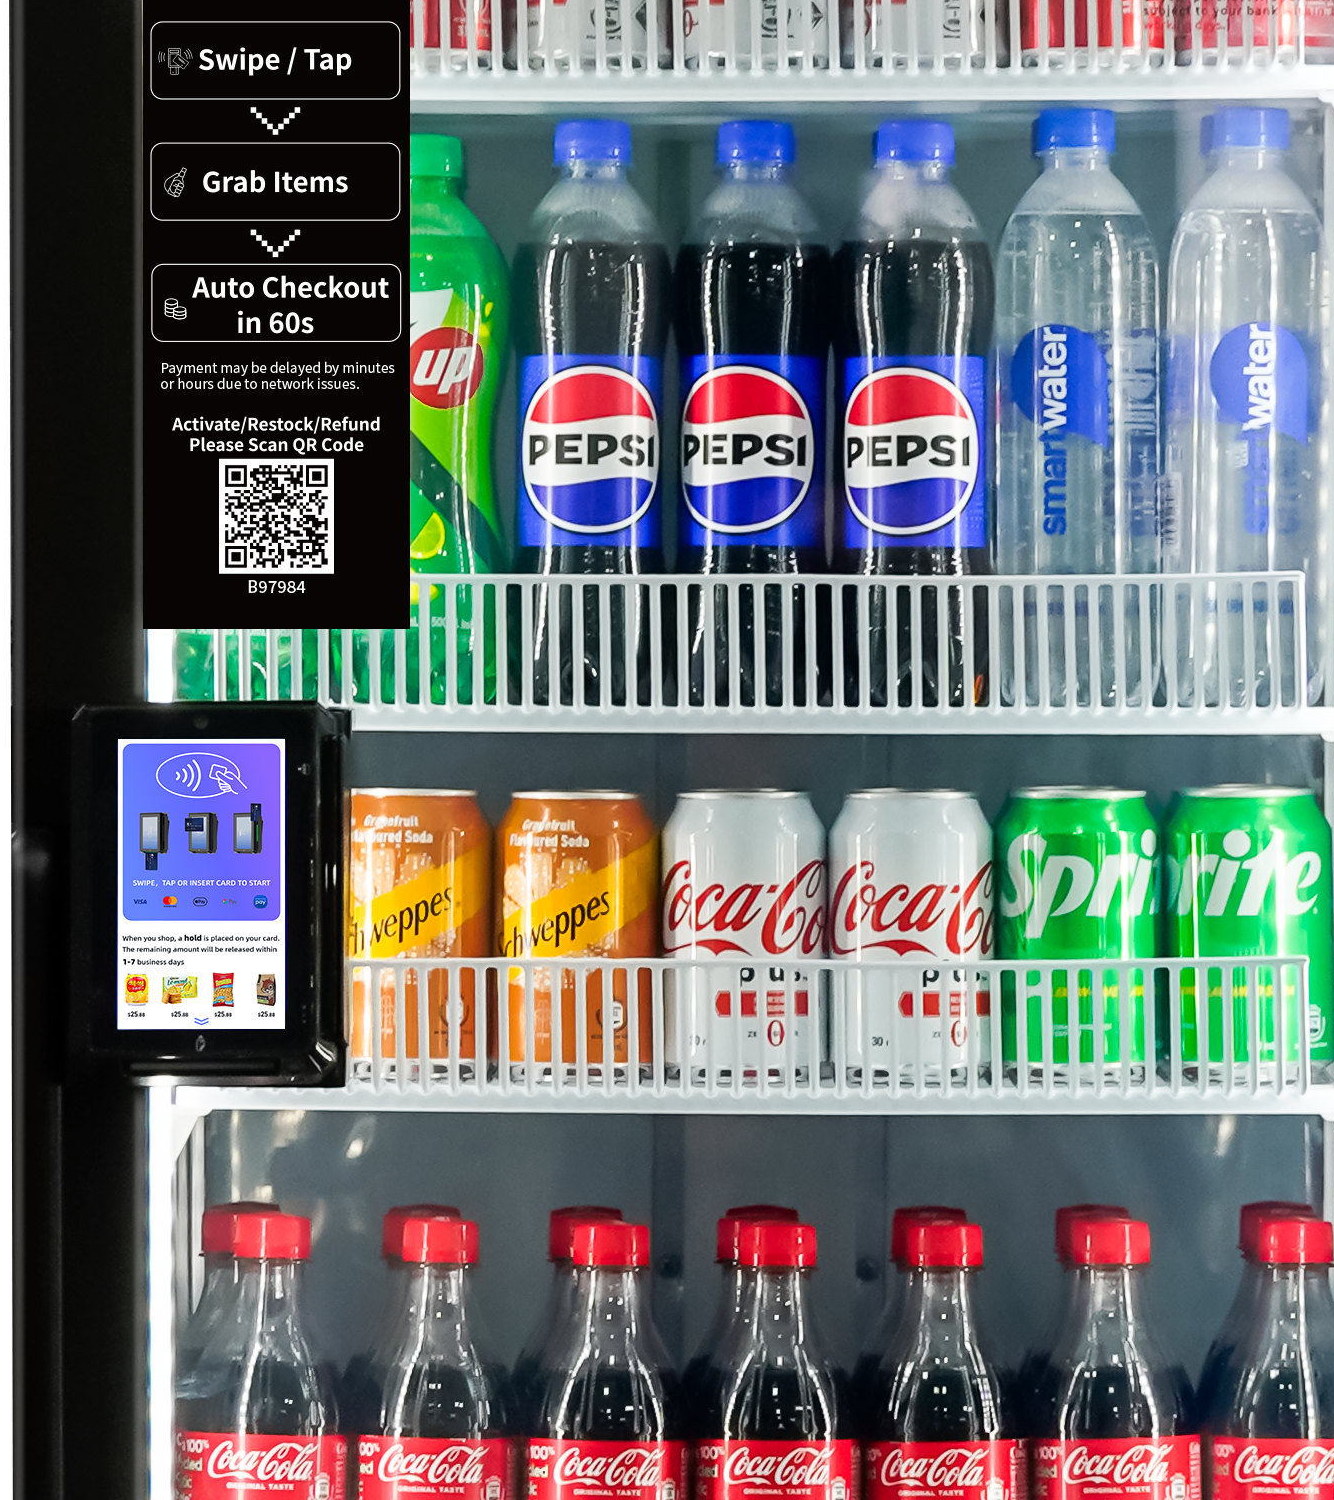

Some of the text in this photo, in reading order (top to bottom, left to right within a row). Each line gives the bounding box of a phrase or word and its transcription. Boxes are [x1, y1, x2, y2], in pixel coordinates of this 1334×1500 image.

[199, 47, 280, 76] Swipe
[304, 49, 352, 76] Tap
[202, 170, 349, 193] Grab Items
[192, 275, 389, 299] Auto Checkout
[237, 311, 314, 334] in 60s
[161, 362, 395, 376] Payment may be delayed by minutes
[412, 346, 473, 395] up
[1038, 326, 1067, 430] water
[1243, 323, 1275, 430] water
[160, 377, 360, 390] or hours due to network issues.
[171, 416, 381, 434] Activate/Restock/Refund
[189, 437, 364, 455] Please Scan QR Code
[528, 433, 655, 468] PEPSI
[683, 433, 807, 467] PEPSI
[847, 434, 970, 469] PEPSI
[1038, 429, 1067, 536] smart
[248, 579, 306, 594] B97984
[405, 830, 434, 844] Soda
[561, 835, 590, 848] Soda
[132, 879, 271, 888] SWIPE, TAP OR INSERT CARD TO START
[122, 934, 142, 942] When
[158, 934, 176, 943] shop,
[184, 934, 202, 942] hold
[203, 934, 210, 942] is
[211, 934, 234, 943] placed
[263, 934, 280, 942] card.
[136, 946, 172, 954] remaining
[122, 958, 185, 967] 1-7 business days
[207, 1440, 320, 1481] Coca-Cola
[378, 1443, 490, 1484] Coca-Cola
[553, 1447, 666, 1487] Coca-Cola
[723, 1446, 835, 1486] Coca-Cola
[881, 1448, 990, 1487] Coca-Cola
[1062, 1443, 1175, 1485] Coca-Cola
